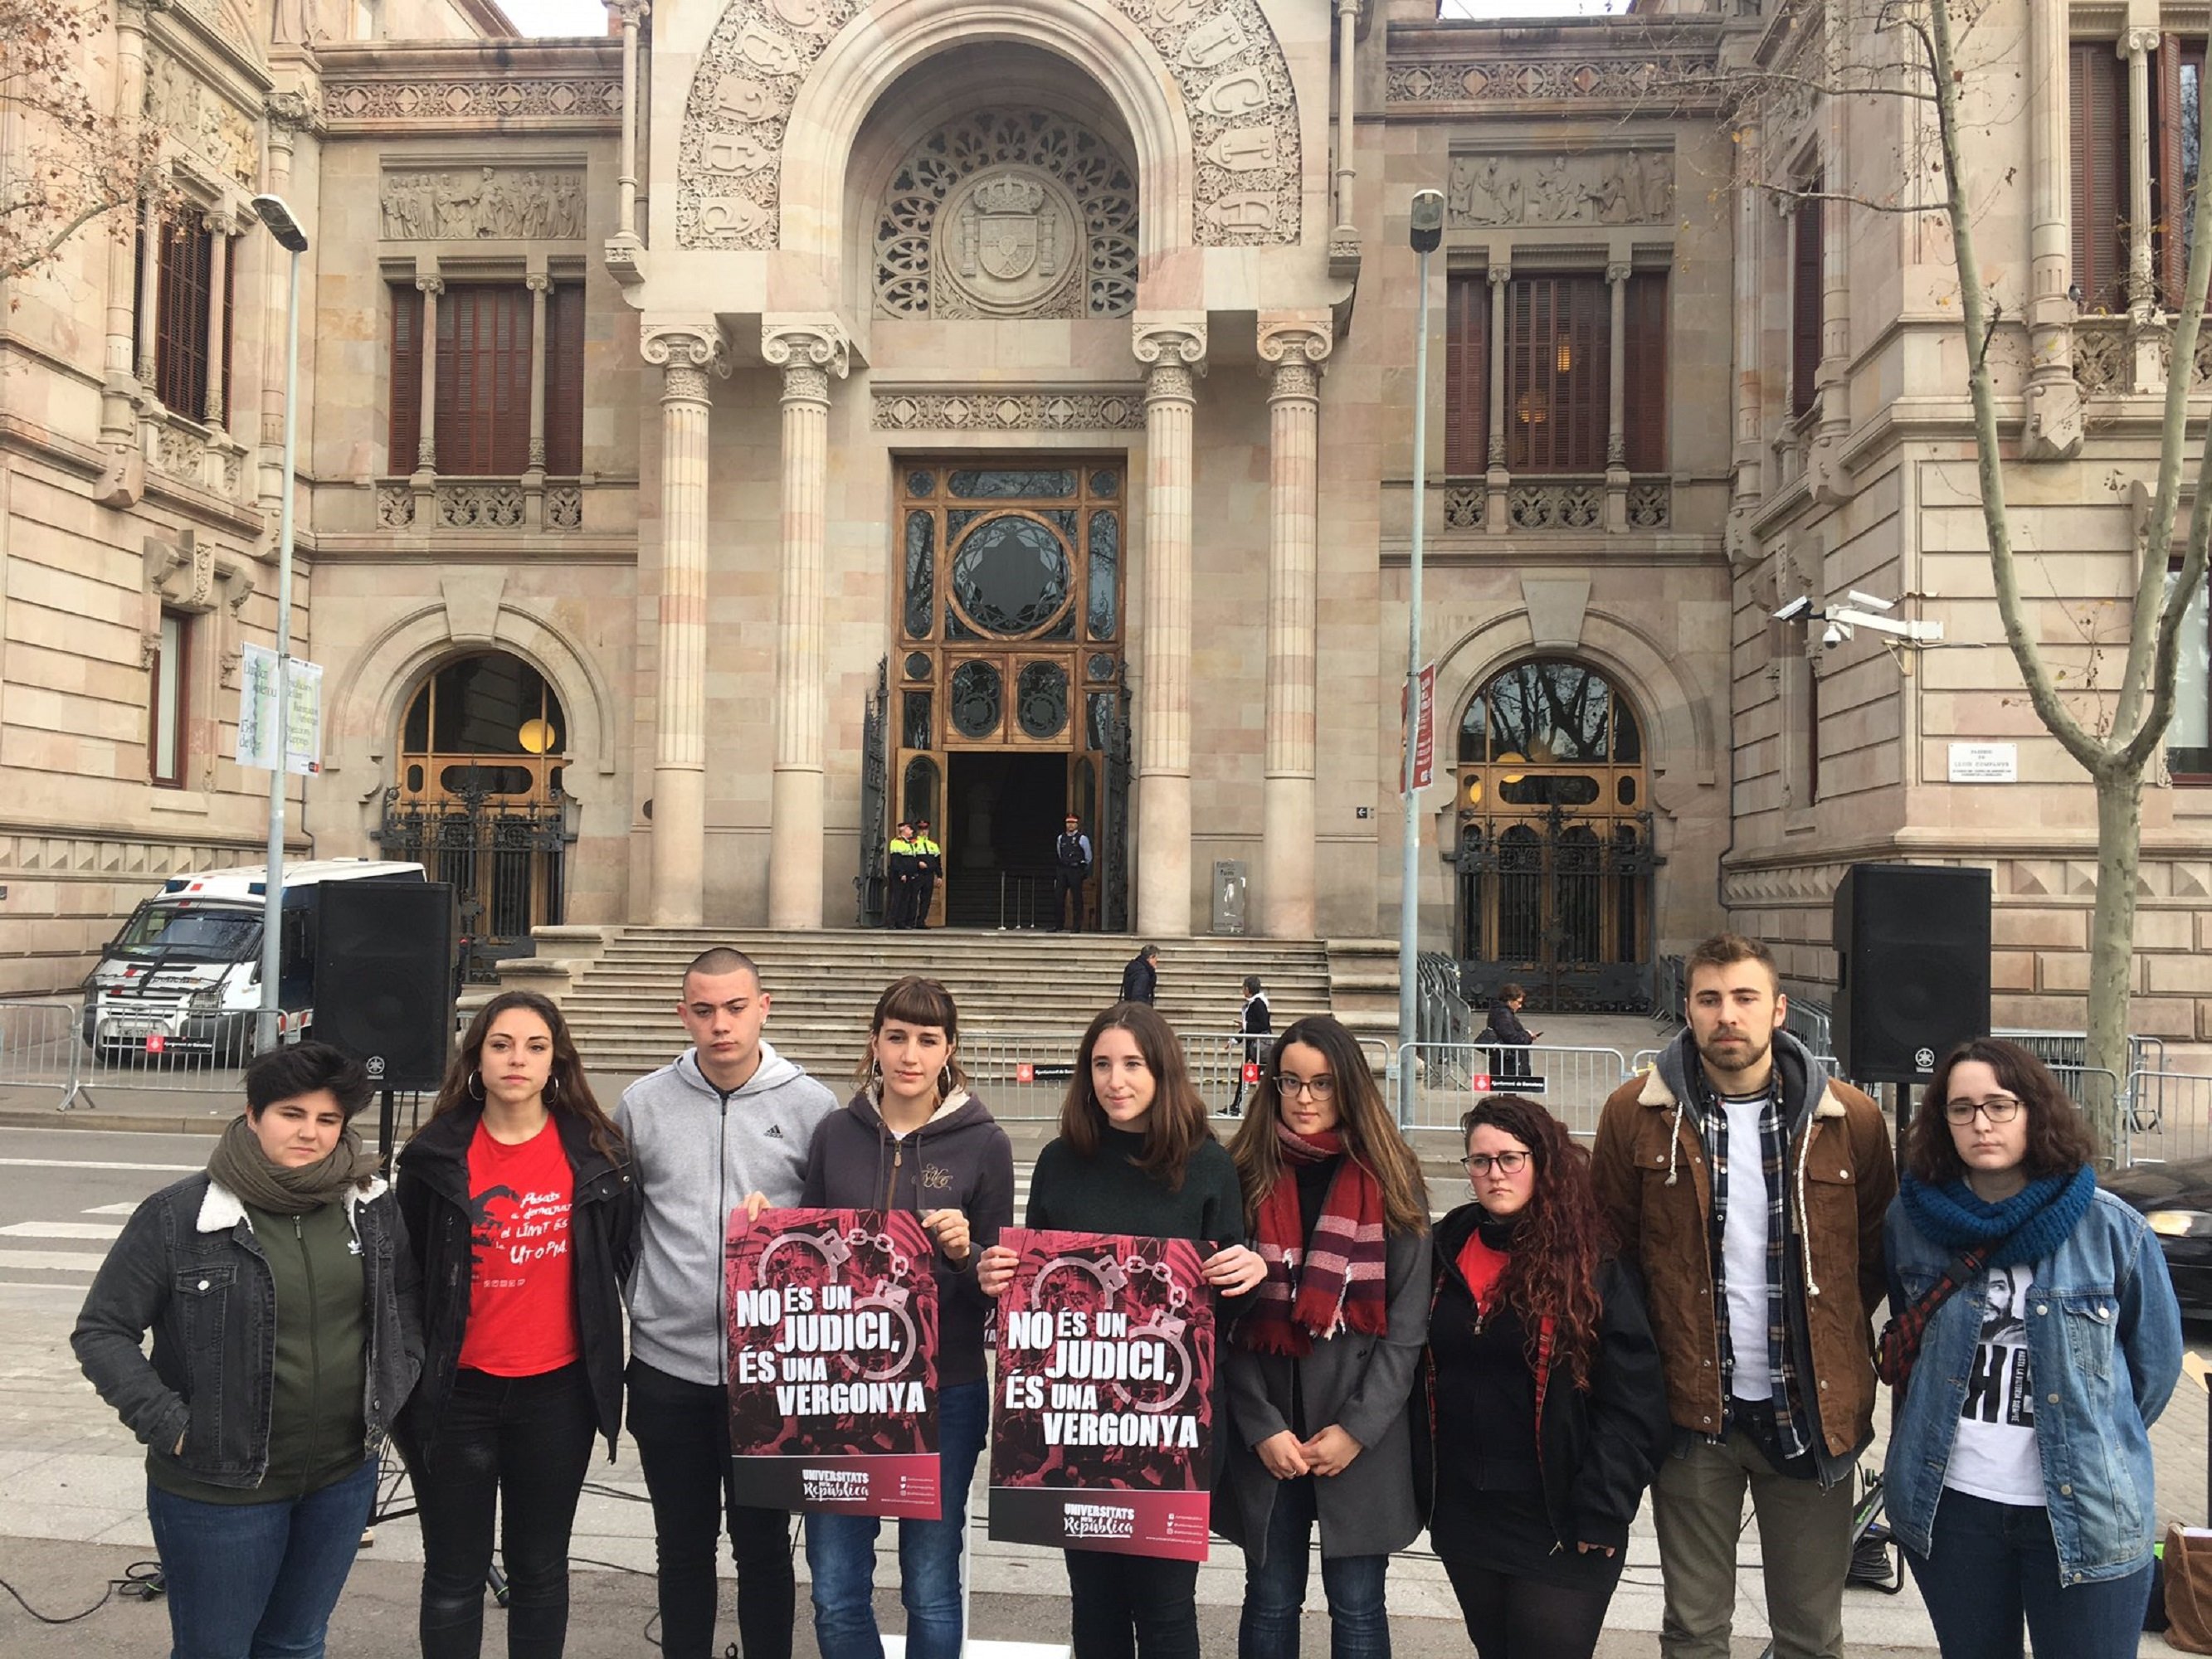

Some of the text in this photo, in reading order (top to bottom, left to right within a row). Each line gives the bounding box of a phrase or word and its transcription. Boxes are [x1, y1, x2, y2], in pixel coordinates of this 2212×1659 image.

[737, 1283, 852, 1327] NO ÉS UN
[774, 1312, 901, 1354] JUDICI,
[1007, 1311, 1055, 1350] NO
[1057, 1307, 1087, 1338] ÉS
[1095, 1311, 1127, 1339] UN
[738, 1345, 828, 1384] ÉS UNA
[1045, 1340, 1175, 1384] JUDICI,
[776, 1381, 927, 1416] VERGONYA
[1005, 1370, 1099, 1411] ÉS UNA
[1042, 1413, 1200, 1448] VERGONYA
[801, 1469, 870, 1484] UNIVERSITATS
[803, 1481, 870, 1501] República
[1063, 1516, 1134, 1538] República
[1064, 1503, 1135, 1520] UNIVERSITATS
